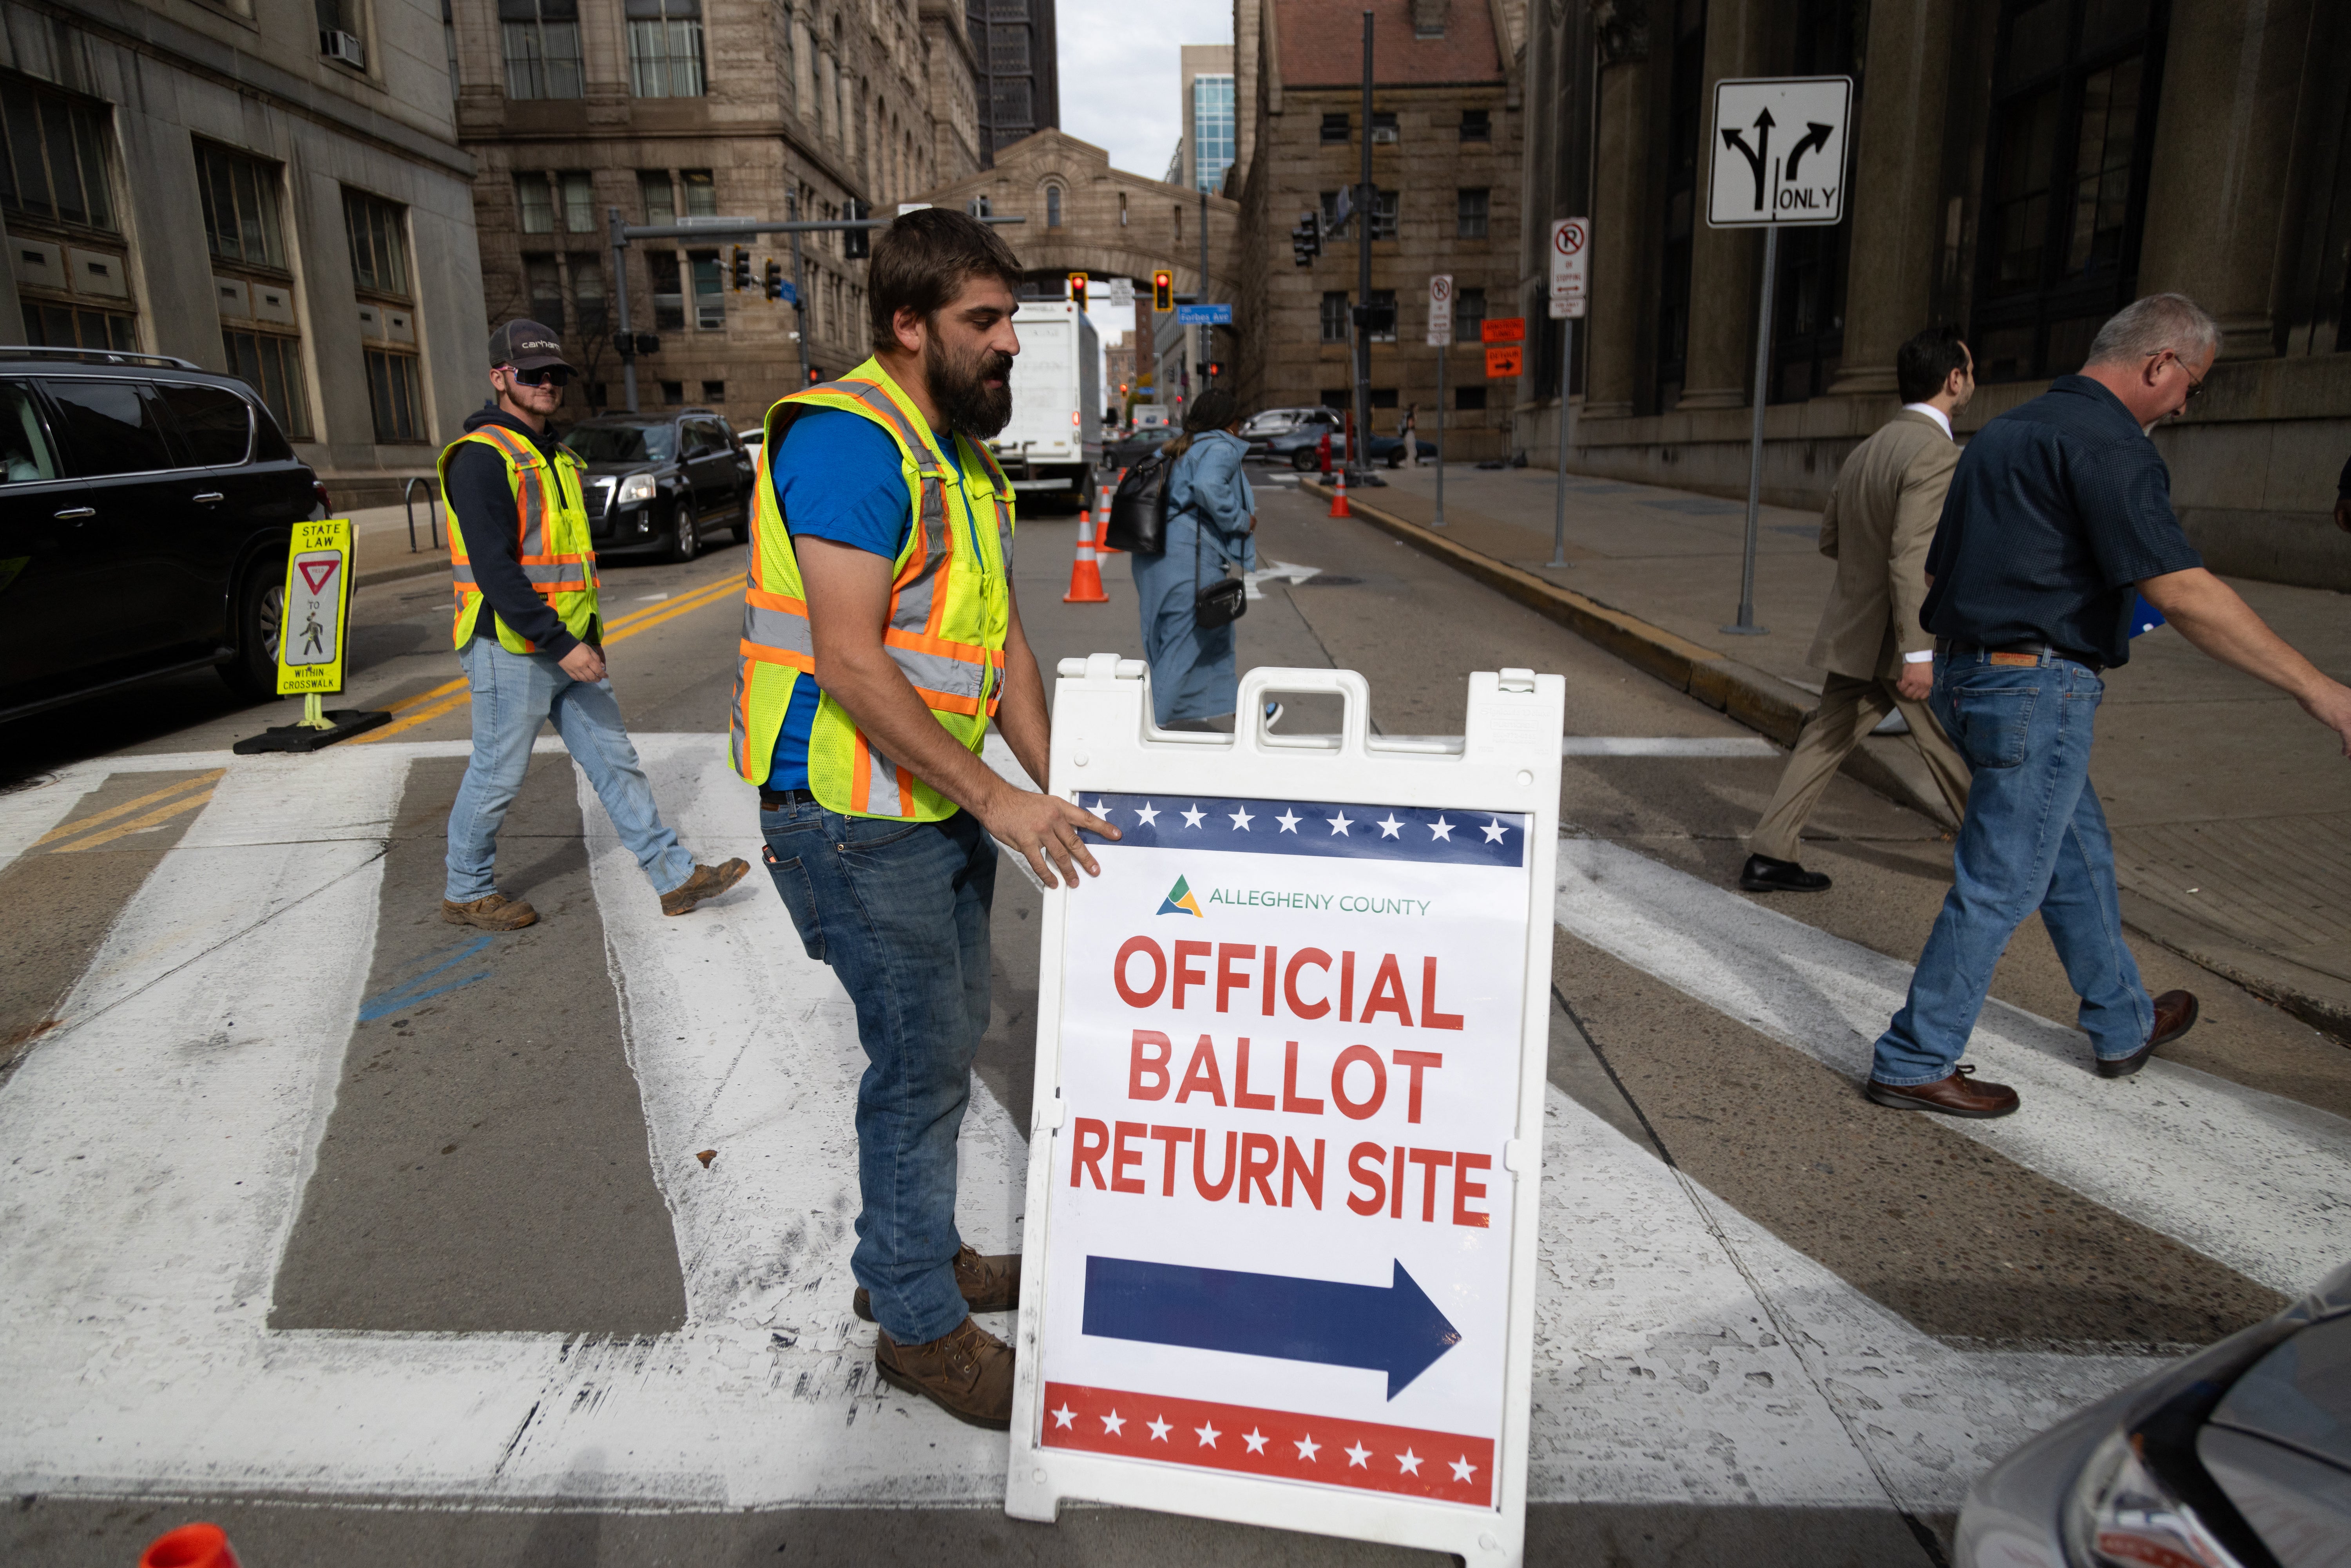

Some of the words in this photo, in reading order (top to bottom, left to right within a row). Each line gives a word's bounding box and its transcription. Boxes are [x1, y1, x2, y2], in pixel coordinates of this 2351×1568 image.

[1780, 187, 1836, 209] ONLY
[1566, 261, 1573, 269] OR
[1556, 273, 1581, 282] STOPPING
[1486, 321, 1522, 330] ARMSTRONG
[302, 524, 341, 536] STATE
[306, 536, 334, 548] LAW
[308, 601, 320, 609] TO
[295, 668, 324, 677] WITHIN
[284, 679, 334, 690] CROSSWALK
[1210, 888, 1333, 911] ALLEGHENY
[1339, 895, 1431, 917] COUNTY
[1114, 936, 1464, 1031] OFFICIAL
[1128, 1029, 1442, 1124] BALLOT
[1070, 1117, 1325, 1211] RETURN
[1347, 1142, 1491, 1228] SITE
